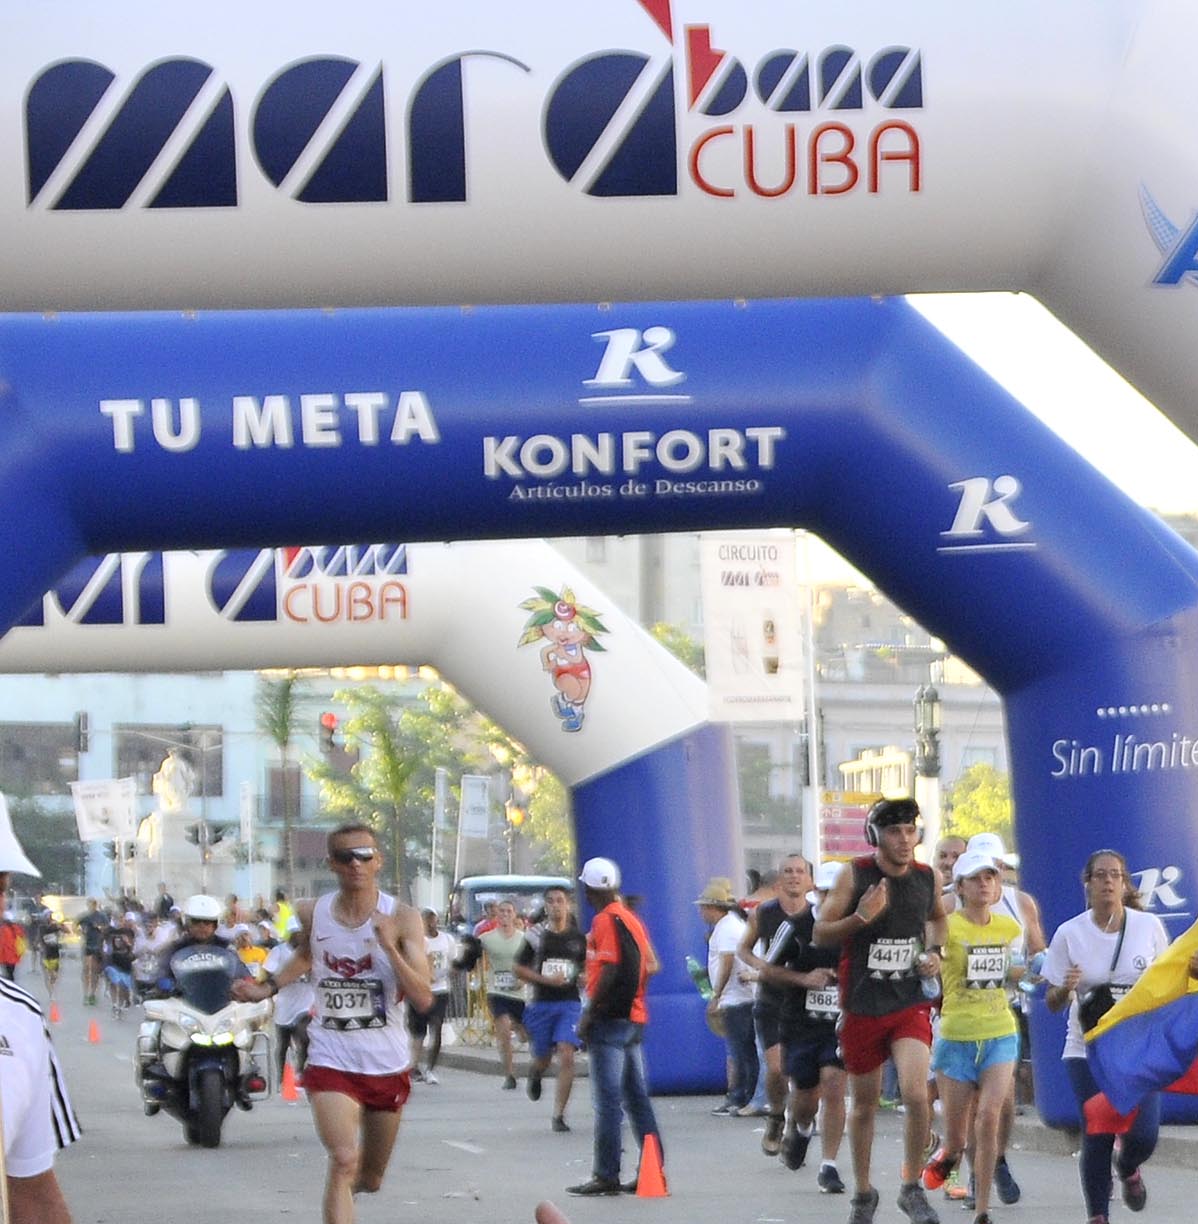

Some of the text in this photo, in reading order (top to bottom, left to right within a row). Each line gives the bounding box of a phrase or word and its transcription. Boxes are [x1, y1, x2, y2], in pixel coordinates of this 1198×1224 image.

[687, 119, 921, 197] CUBA
[99, 391, 443, 452] TU META
[483, 427, 786, 479] KONFORT
[509, 478, 760, 499] Artículos de Descanso
[718, 545, 778, 561] CIRCUITO
[283, 580, 408, 622] CUBA
[1050, 738, 1100, 776] Sin
[872, 949, 911, 963] 4417
[971, 958, 1003, 973] 4423
[324, 992, 368, 1010] 2037
